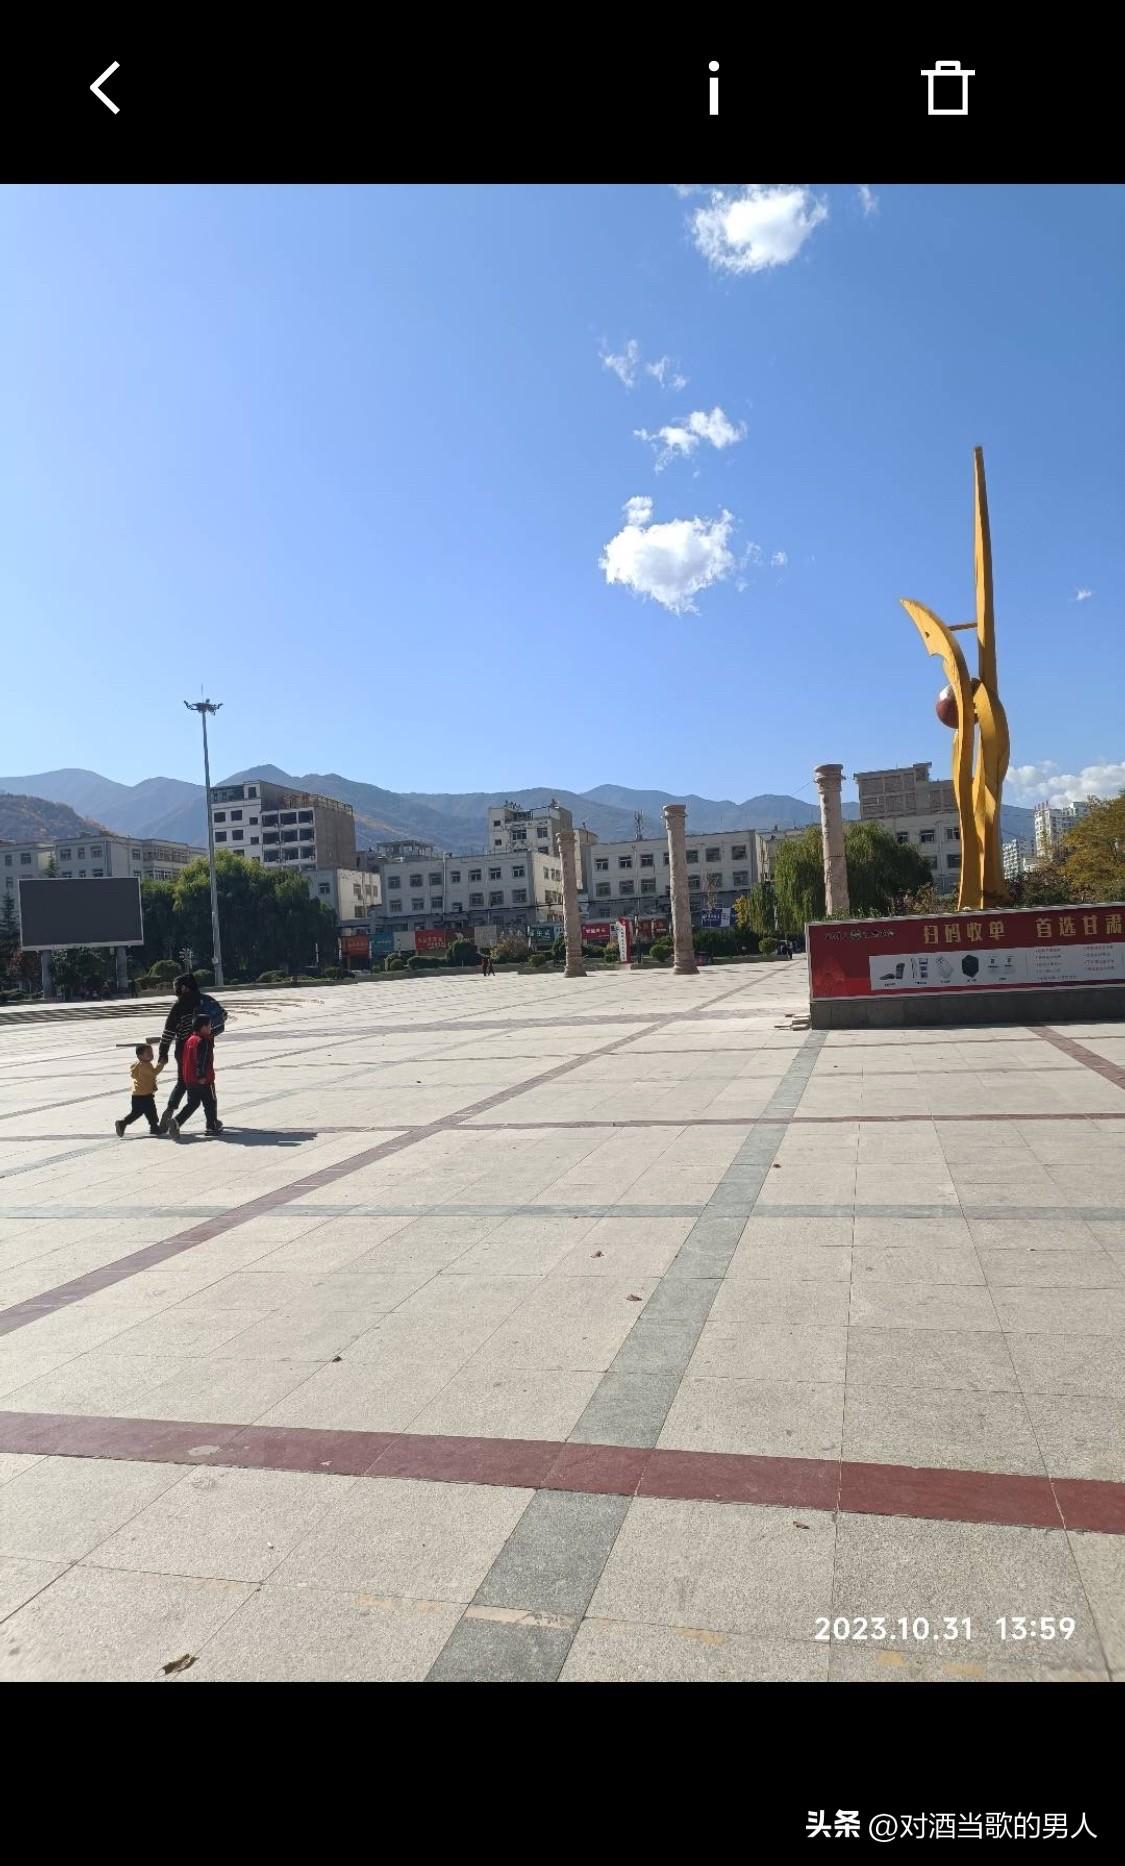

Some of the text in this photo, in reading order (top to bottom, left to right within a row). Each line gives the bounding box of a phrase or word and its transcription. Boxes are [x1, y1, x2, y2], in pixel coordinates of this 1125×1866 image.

[923, 921, 1006, 945] 扫码收单
[1035, 913, 1122, 938] 首选甘肃
